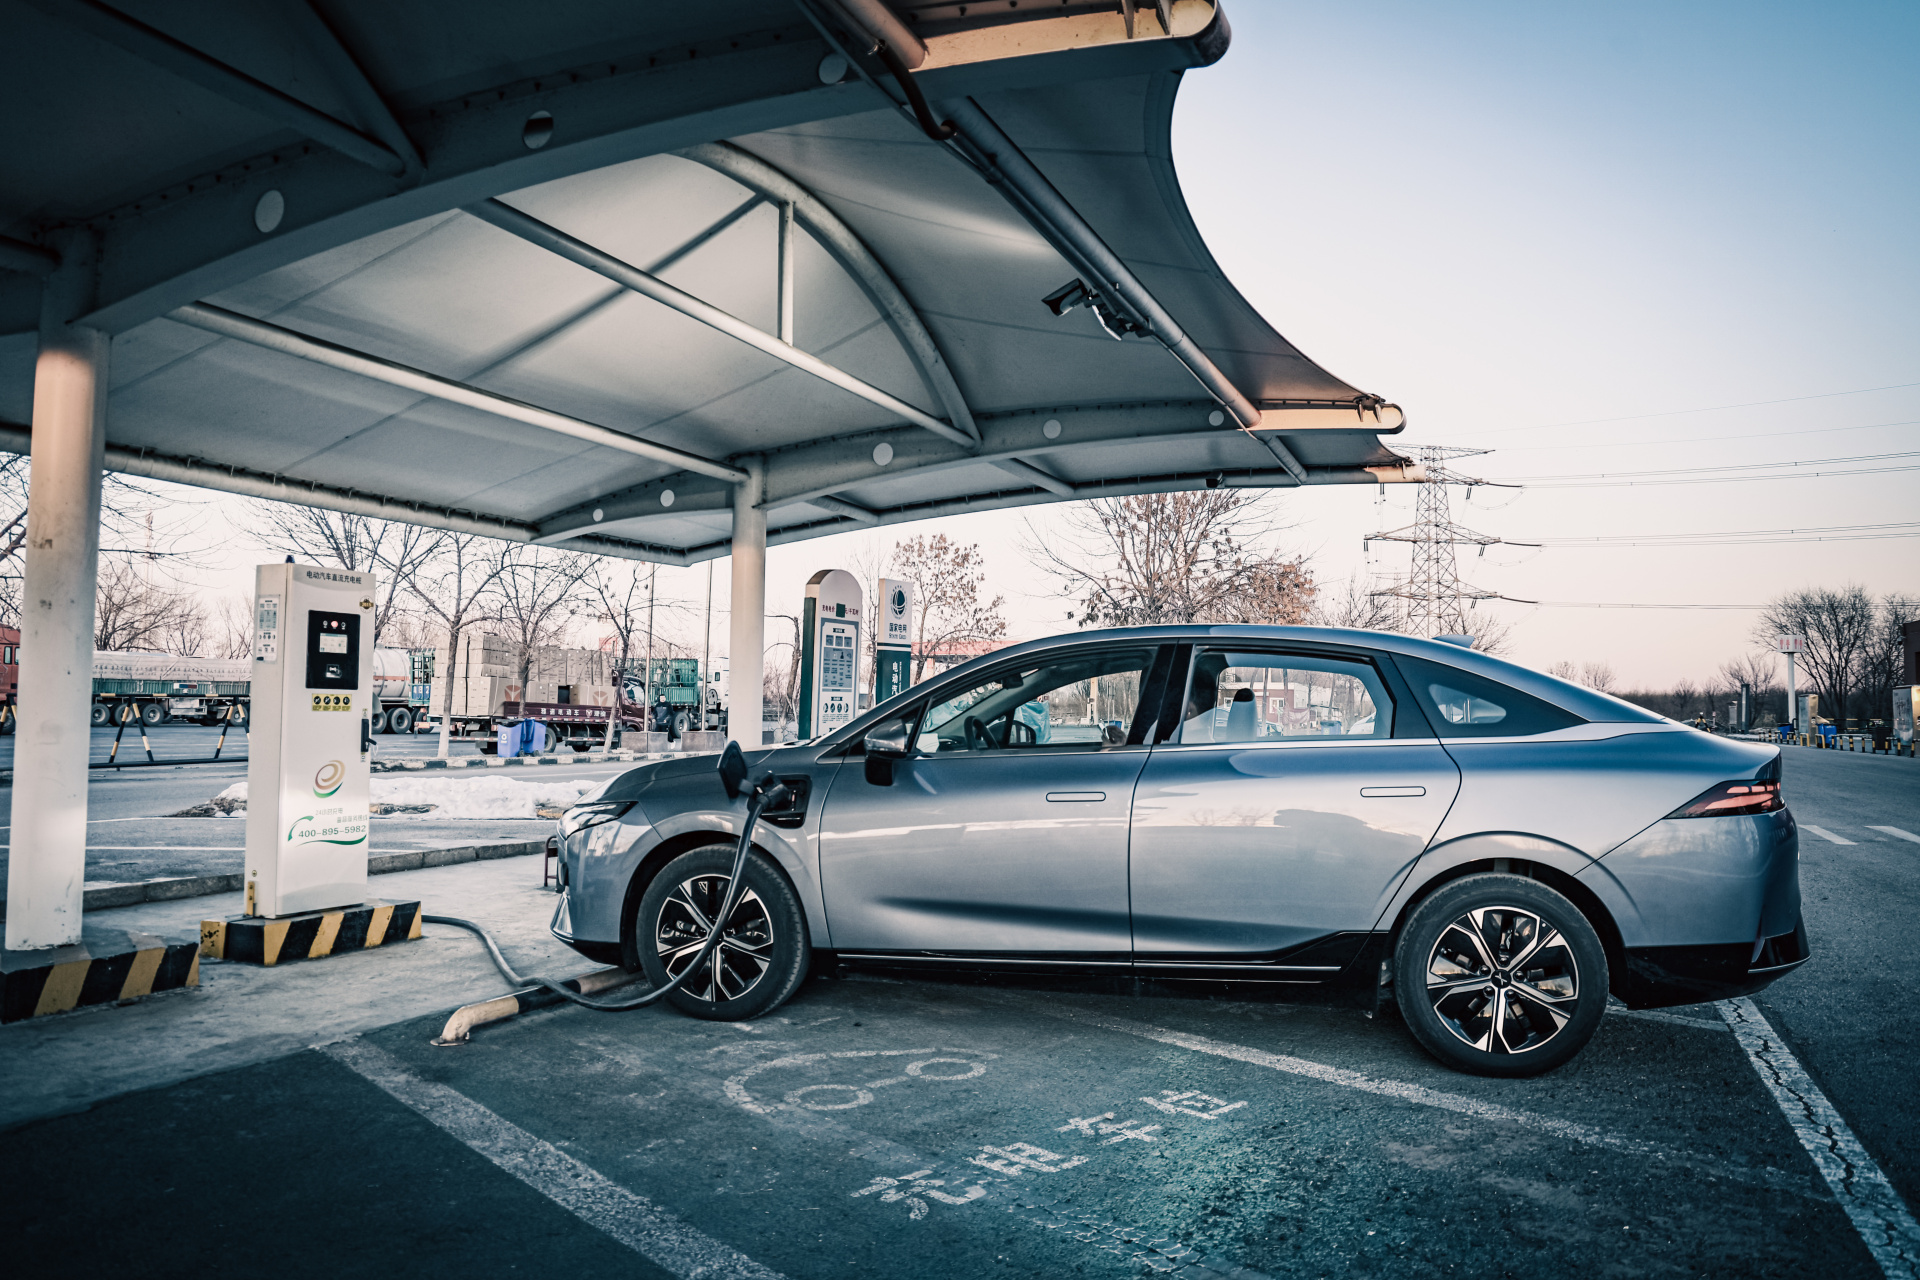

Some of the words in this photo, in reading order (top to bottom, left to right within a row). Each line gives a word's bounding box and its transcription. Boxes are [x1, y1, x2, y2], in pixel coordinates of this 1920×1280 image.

[306, 570, 362, 585] 电动汽车直流充电桩
[889, 622, 907, 633] 国家电网
[298, 825, 367, 838] 400-895-5982
[850, 1089, 1249, 1221] 充电车位
